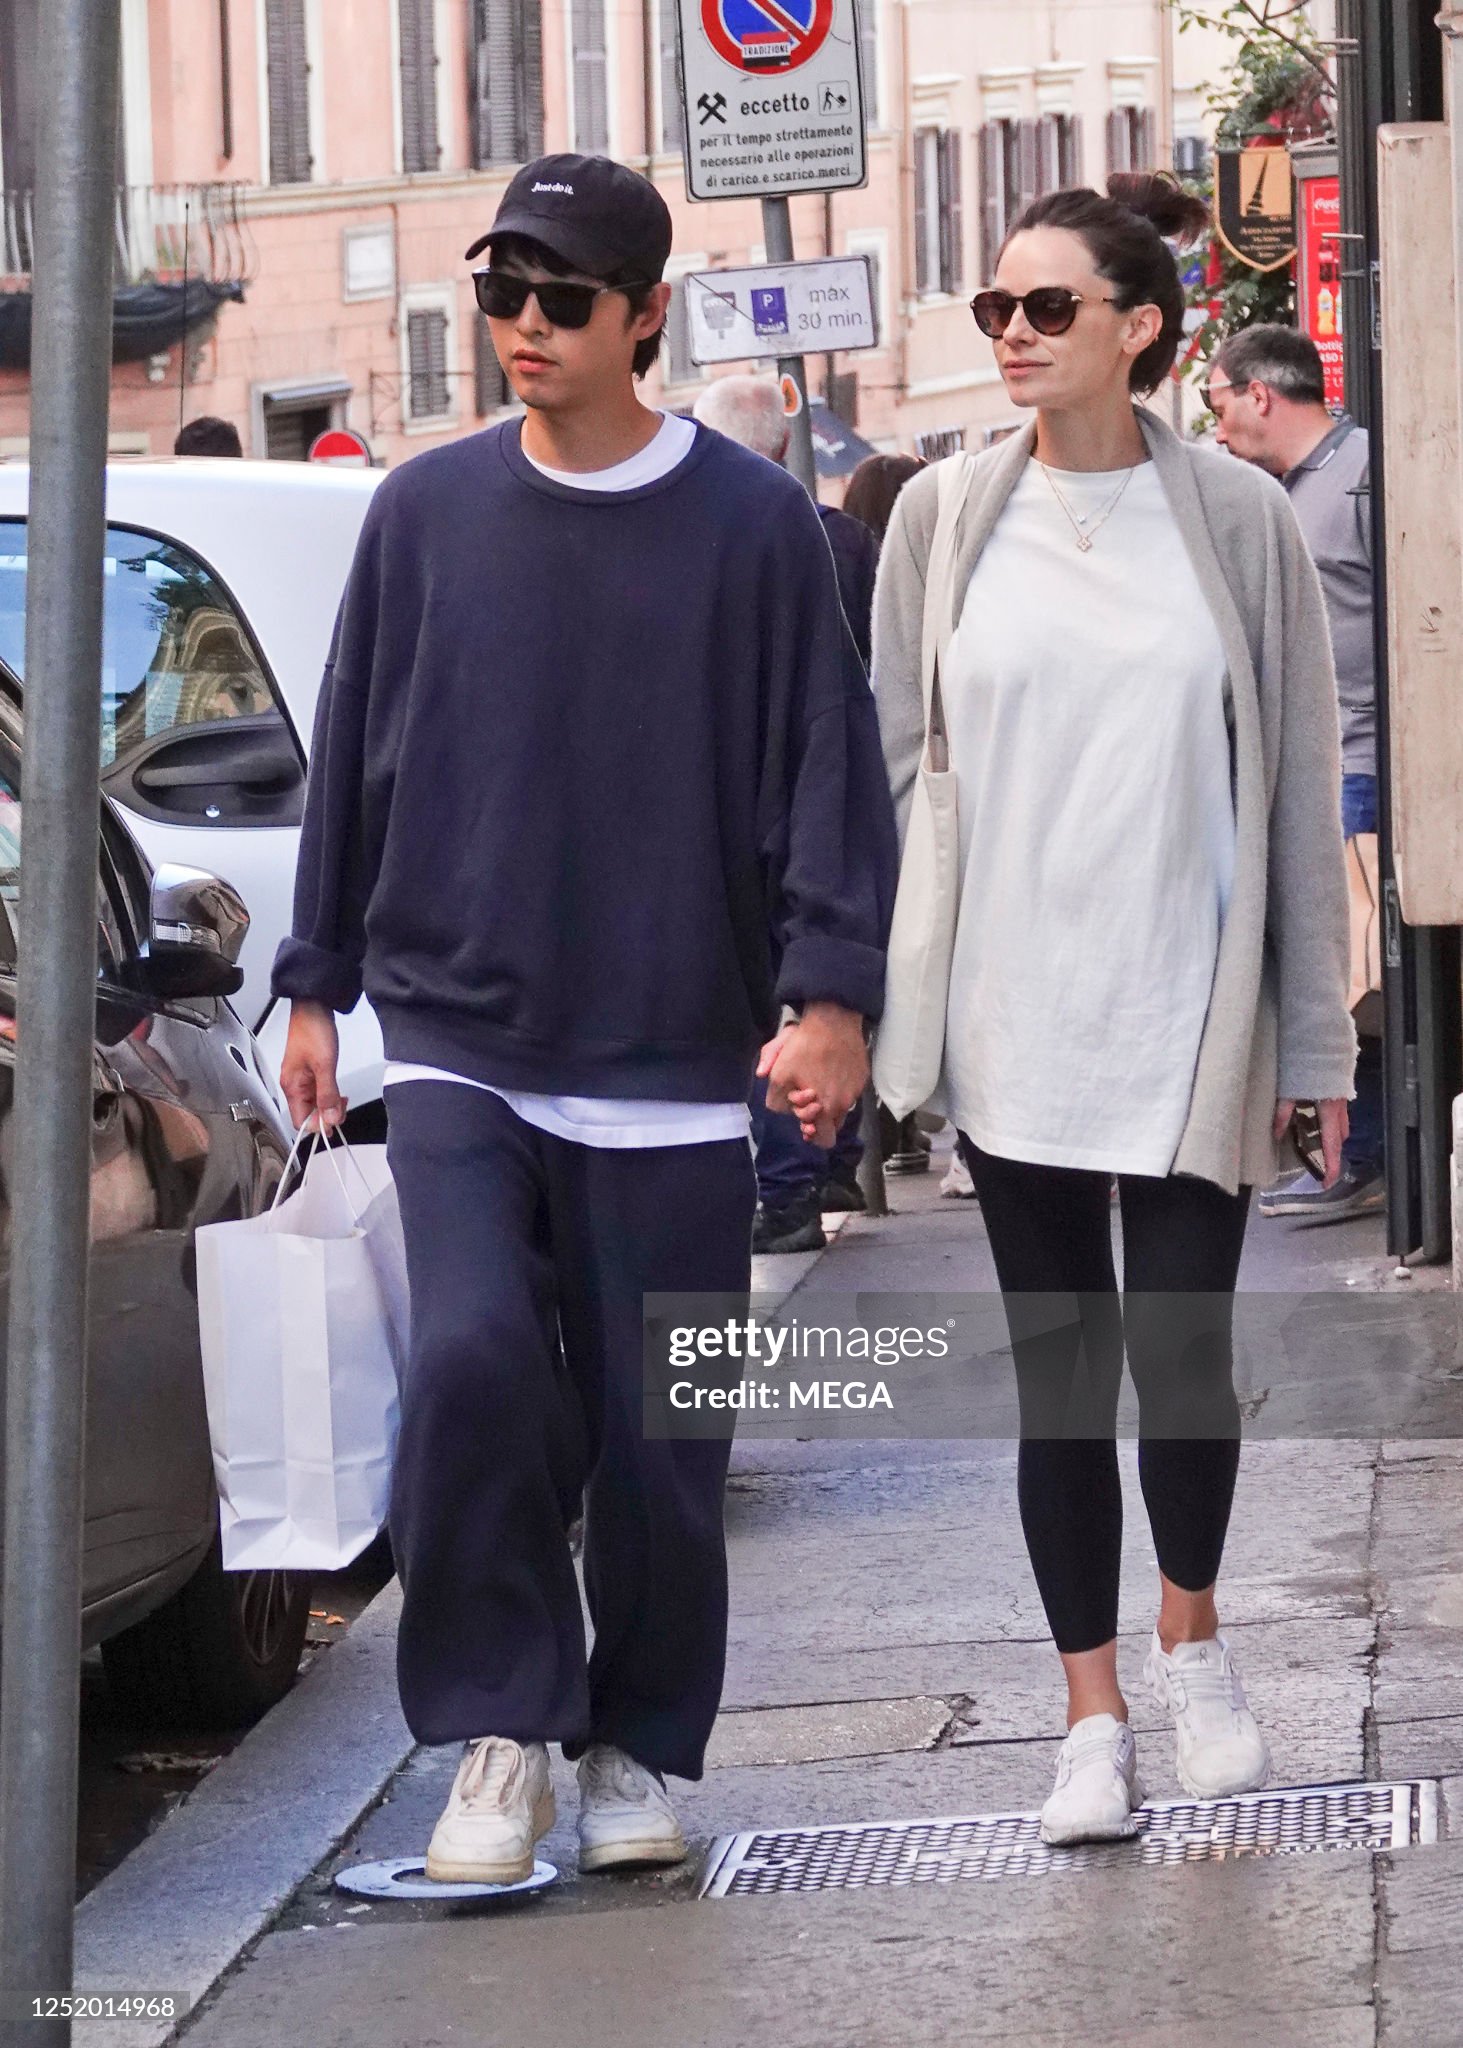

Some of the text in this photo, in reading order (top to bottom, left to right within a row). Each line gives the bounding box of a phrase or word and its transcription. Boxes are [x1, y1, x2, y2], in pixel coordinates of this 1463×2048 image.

[740, 92, 810, 115] eccetto
[700, 125, 853, 150] per il tempo strettamento
[700, 144, 855, 168] necessario alle operazioni
[706, 175, 717, 187] di
[722, 172, 759, 186] carico
[763, 173, 770, 183] e
[773, 167, 815, 182] scarico
[531, 182, 552, 192] Just
[552, 182, 564, 192] do
[763, 293, 774, 308] P
[809, 286, 850, 303] max
[799, 312, 822, 330] 30
